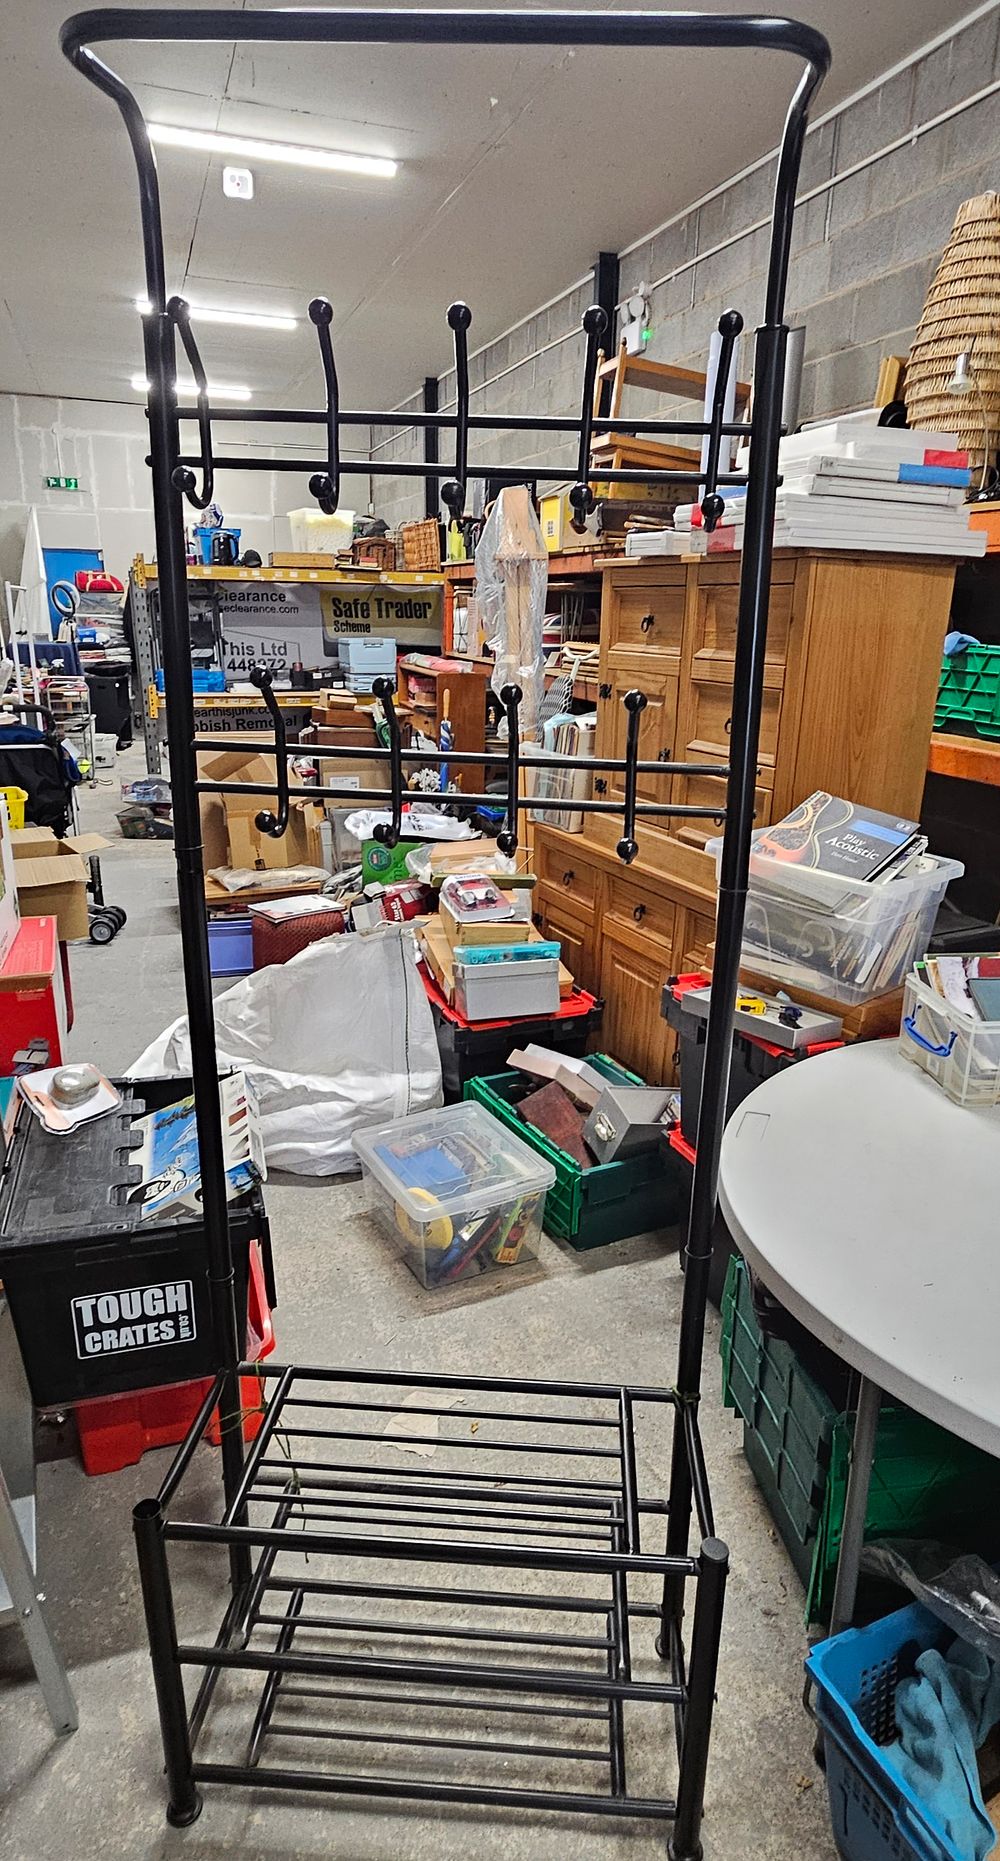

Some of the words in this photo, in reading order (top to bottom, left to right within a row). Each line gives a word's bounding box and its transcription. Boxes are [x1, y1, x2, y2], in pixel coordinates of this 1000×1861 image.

[332, 597, 371, 619] Safe
[374, 597, 432, 619] Trader
[333, 619, 371, 633] Scheme
[261, 641, 287, 656] Ltd
[236, 715, 297, 730] Remoal
[825, 836, 879, 860] Acoustic
[842, 833, 867, 846] Play
[75, 1284, 188, 1328] TOUGH
[84, 1319, 176, 1353] CRATES
